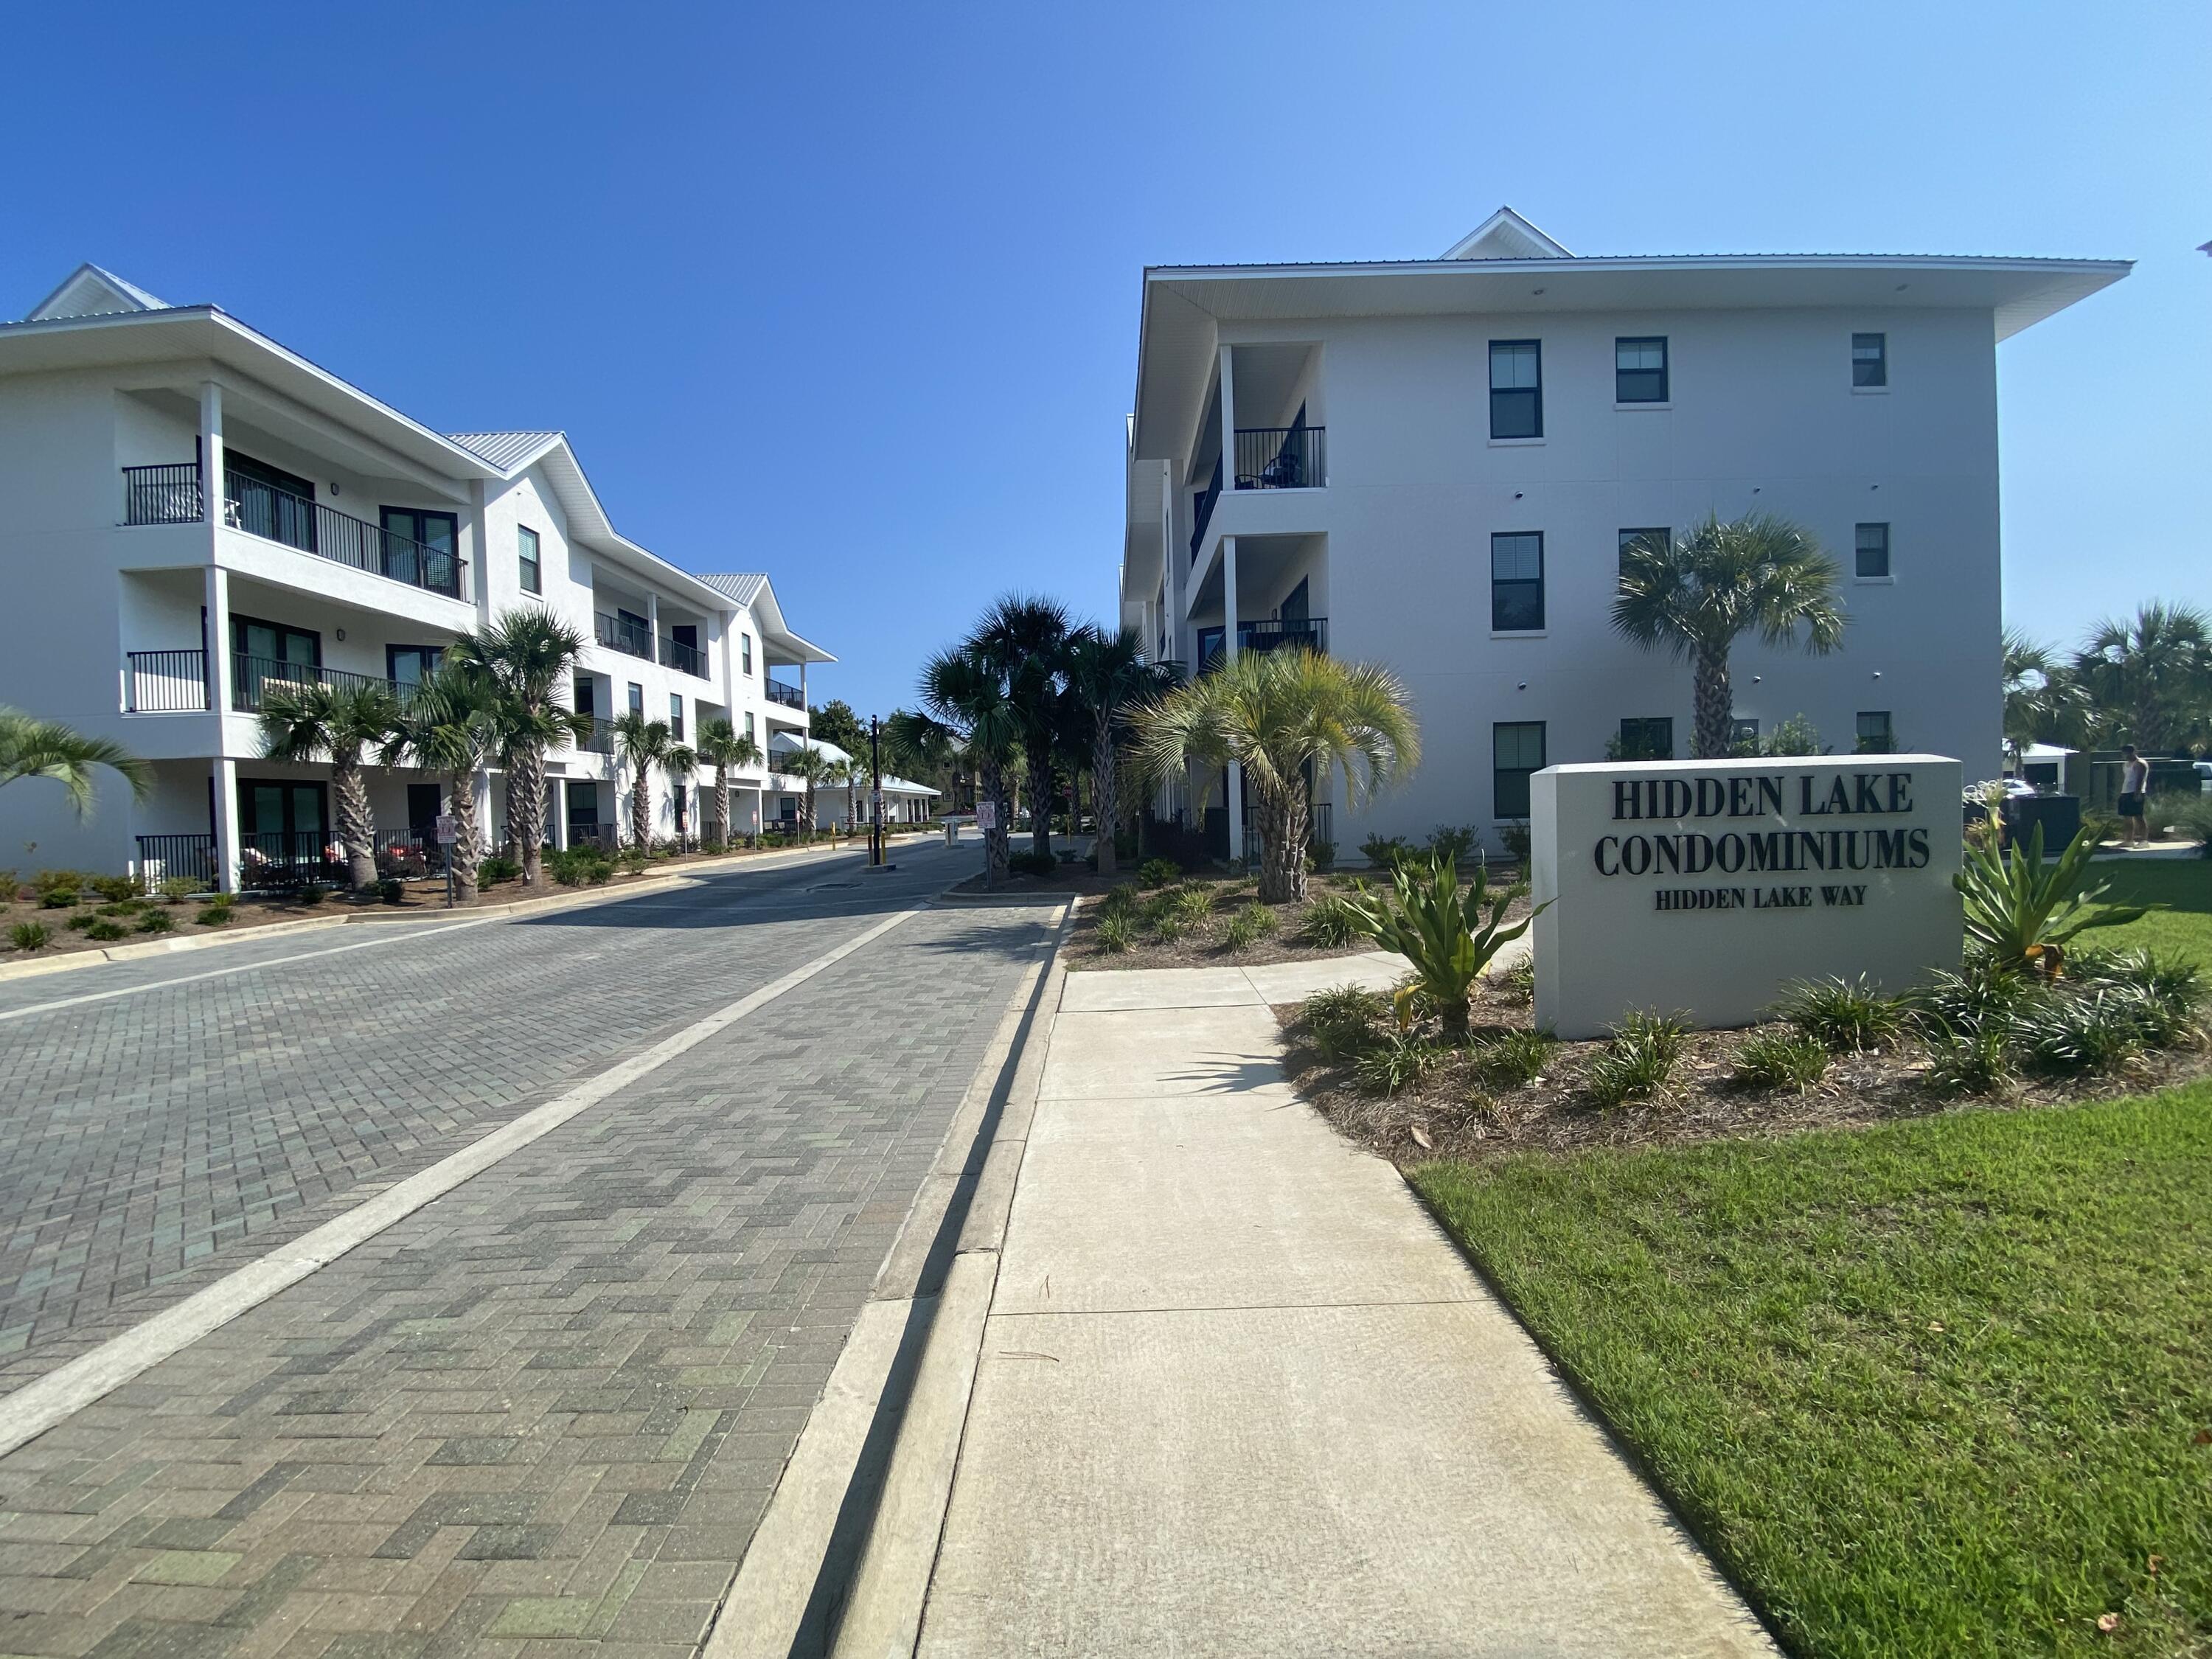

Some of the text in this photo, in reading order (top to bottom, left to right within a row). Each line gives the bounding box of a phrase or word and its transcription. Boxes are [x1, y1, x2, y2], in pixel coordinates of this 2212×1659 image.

[1611, 773, 1913, 820] HIDDEN LAKE
[1594, 828, 1930, 877] CONDOMINIUMS
[1655, 885, 1868, 911] HIDDEN LAKE WAY
